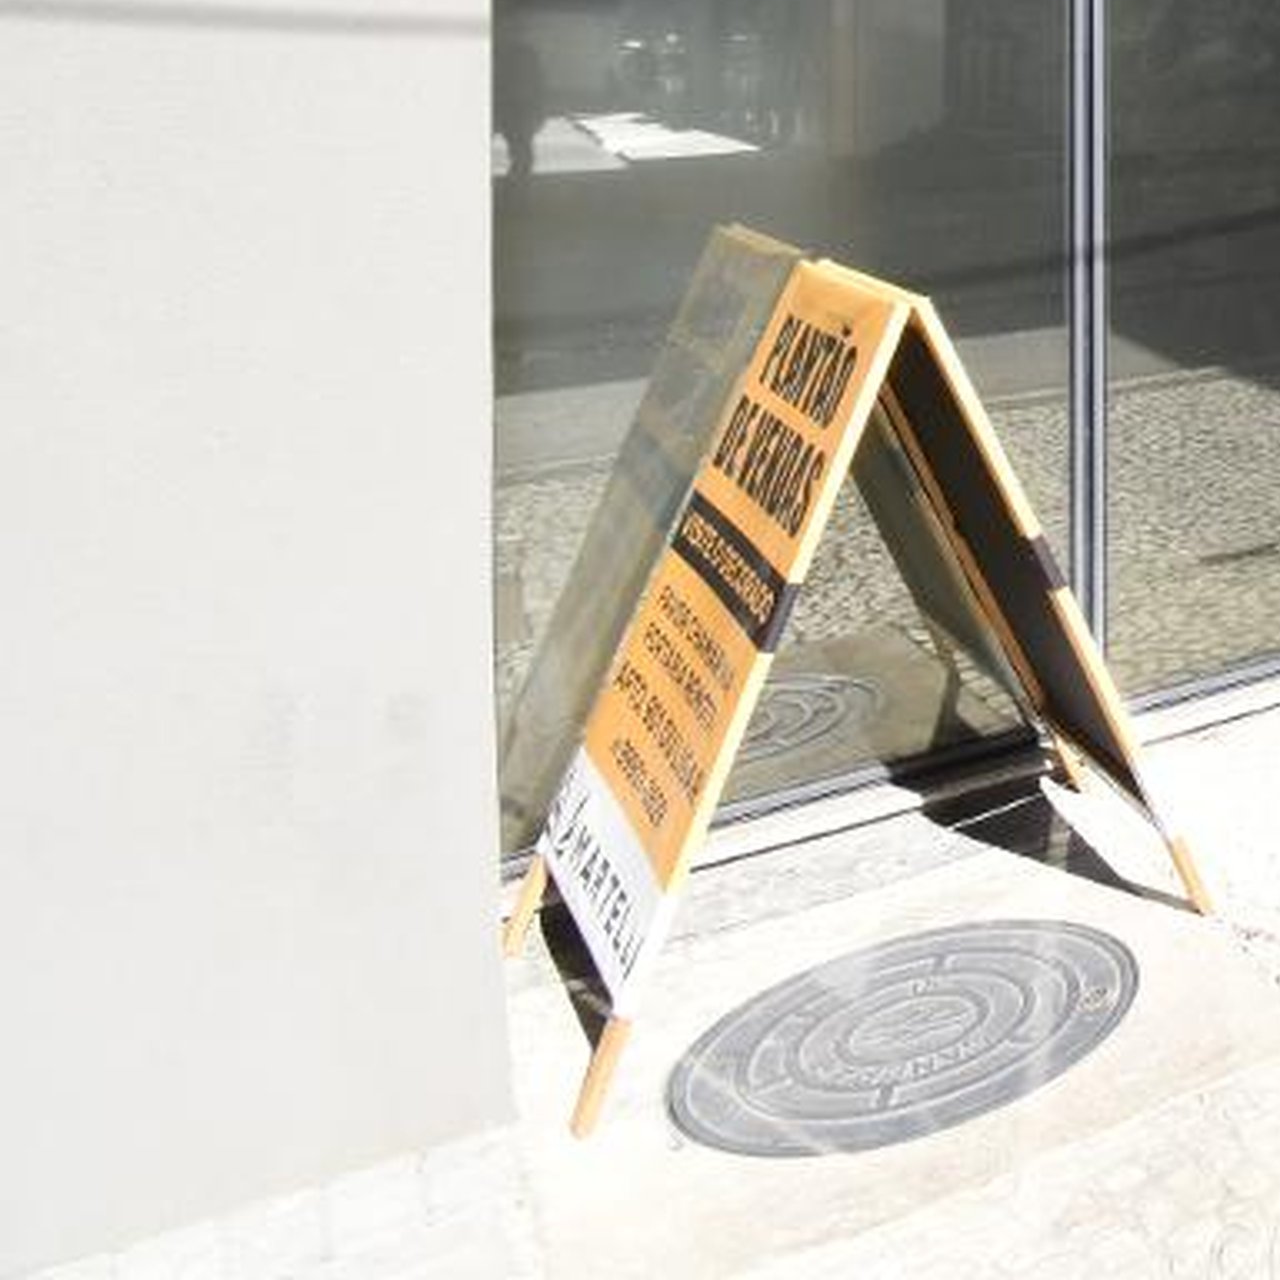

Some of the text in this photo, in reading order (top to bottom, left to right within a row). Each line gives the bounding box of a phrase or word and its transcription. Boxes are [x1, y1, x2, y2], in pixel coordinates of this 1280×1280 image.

[758, 313, 858, 431] PLANTÃO
[712, 394, 826, 539] DE VENDAS
